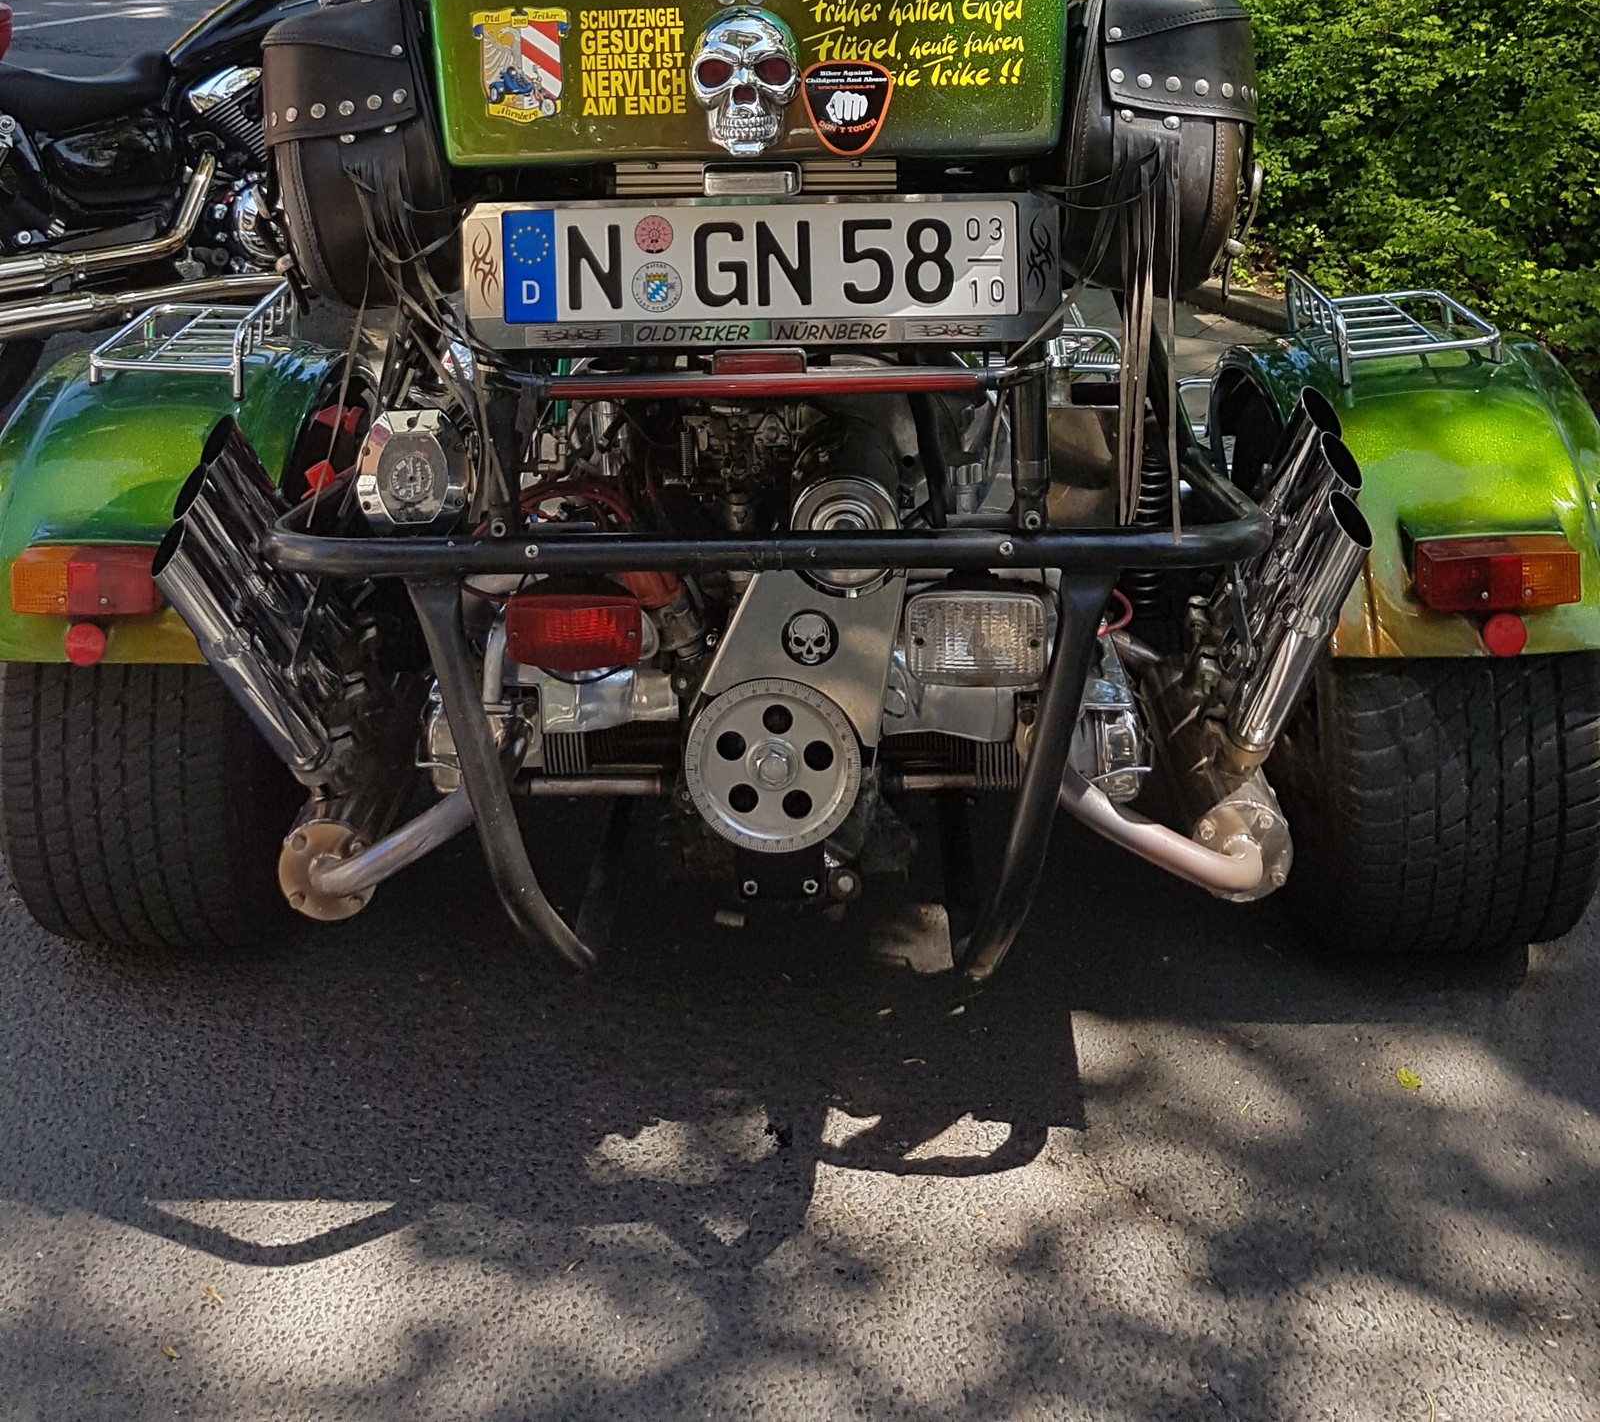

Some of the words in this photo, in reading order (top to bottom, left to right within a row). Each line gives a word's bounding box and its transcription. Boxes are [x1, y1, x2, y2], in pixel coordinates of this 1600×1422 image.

[484, 14, 501, 23] Old
[579, 8, 684, 29] SCHUTZENGEL
[580, 29, 685, 55] GESUCHT
[802, 25, 902, 61] Flügel,
[909, 33, 958, 59] heute
[963, 31, 1024, 58] fahren
[581, 53, 650, 69] MEINER
[656, 53, 685, 68] IST
[843, 69, 873, 77] Against
[923, 55, 990, 87] Trike
[582, 69, 687, 97] NERVLICH
[582, 97, 617, 116] AM
[625, 96, 687, 114] ENDE
[847, 118, 878, 133] TOUCH
[966, 217, 1003, 241] 03
[567, 224, 623, 310] N
[694, 220, 813, 307] GN
[842, 218, 955, 305] 58
[522, 280, 540, 305] D
[970, 278, 1005, 305] 10
[636, 324, 751, 342] OLDTRIKER
[775, 320, 888, 341] NÜRNBERG
